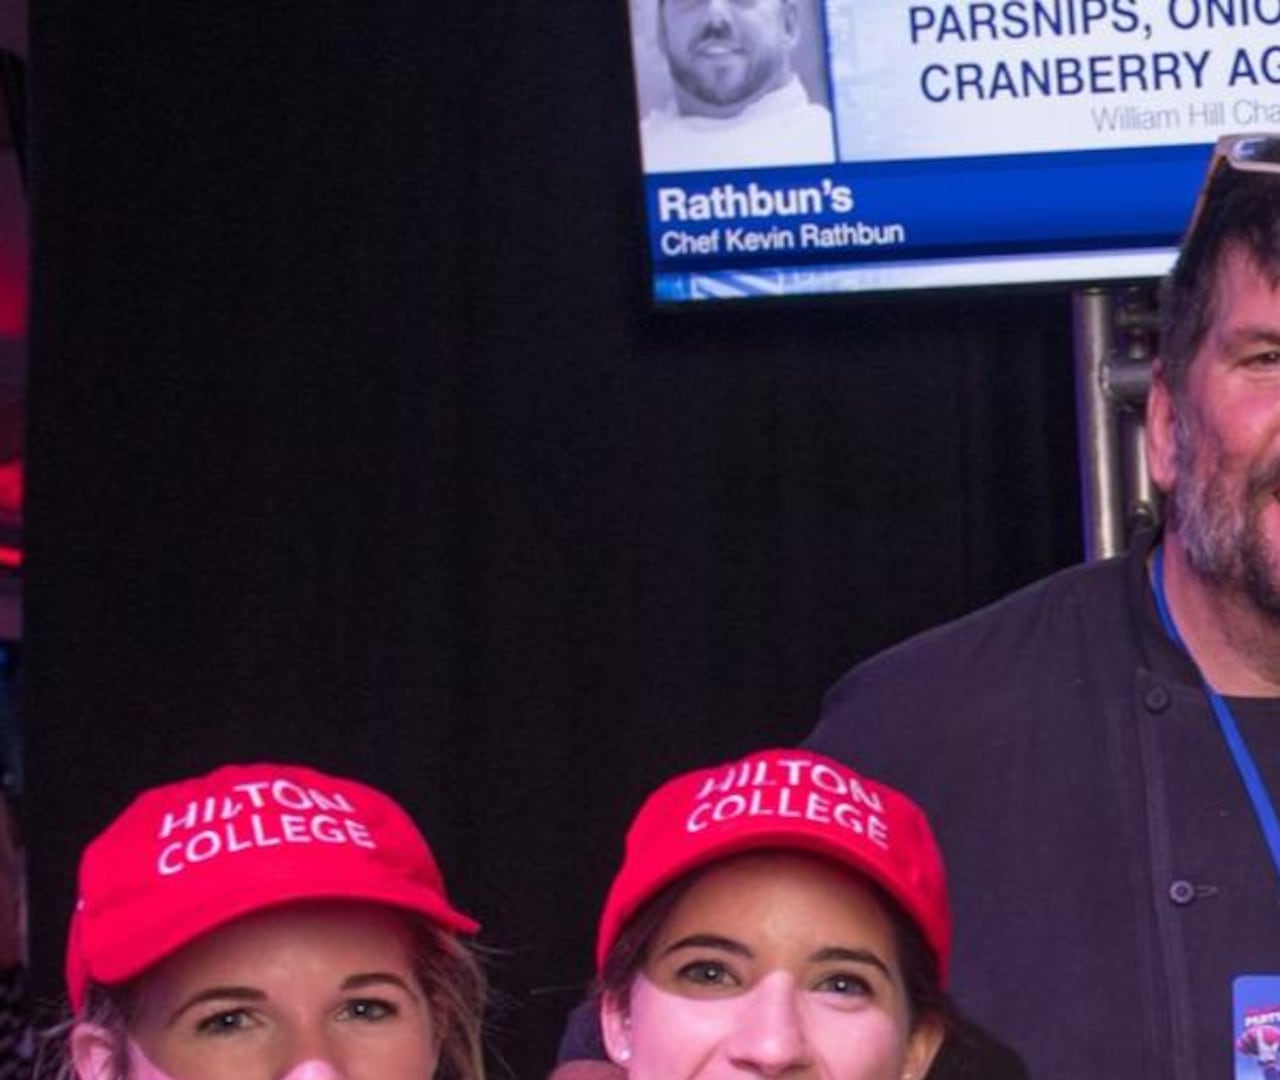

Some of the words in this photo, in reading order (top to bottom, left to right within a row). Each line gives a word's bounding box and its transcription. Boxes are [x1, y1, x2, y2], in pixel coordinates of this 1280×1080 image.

[909, 0, 1152, 43] PARSNIPS,
[920, 50, 1211, 102] CRANBERRY
[1091, 104, 1181, 131] William
[1188, 102, 1225, 126] Hill
[658, 179, 853, 222] Rathbun's
[661, 228, 718, 255] Chef
[726, 226, 794, 250] Kevin
[801, 221, 905, 247] Rathbun
[158, 779, 355, 838] HILTON
[695, 760, 884, 814] HILTON
[157, 814, 376, 875] COLLEGE
[686, 787, 888, 850] COLLEGE
